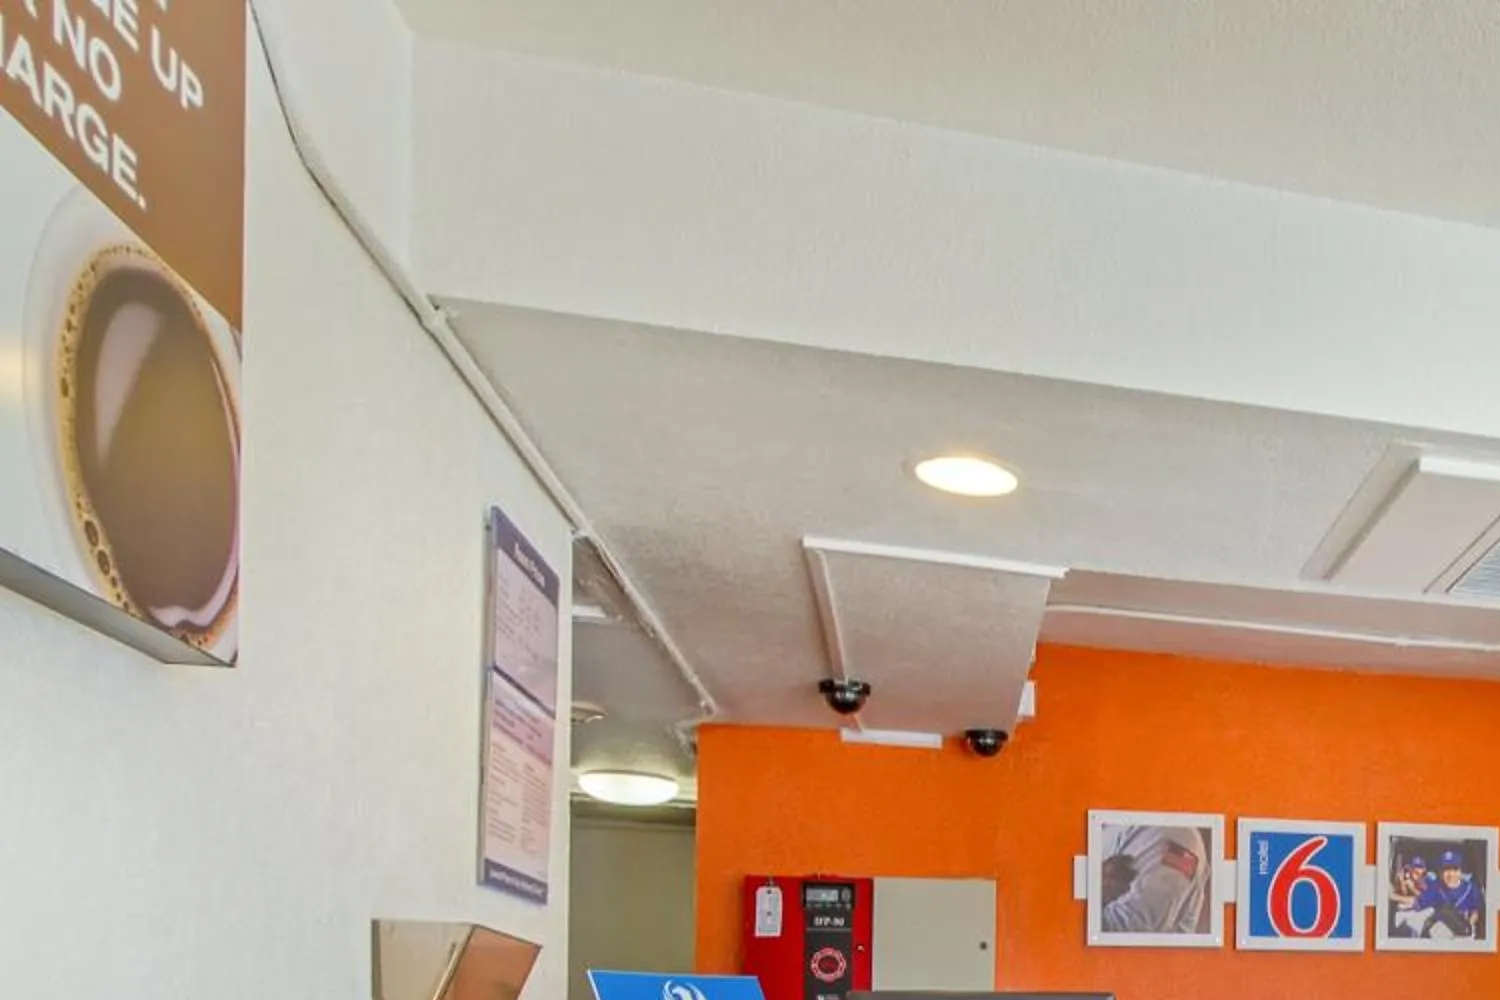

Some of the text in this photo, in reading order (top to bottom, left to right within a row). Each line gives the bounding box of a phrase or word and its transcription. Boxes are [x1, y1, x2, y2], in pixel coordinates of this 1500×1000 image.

[54, 0, 121, 100] NO
[152, 25, 203, 110] UP
[0, 12, 147, 212] ARGE.
[1257, 839, 1269, 875] motel
[1267, 835, 1341, 939] 6
